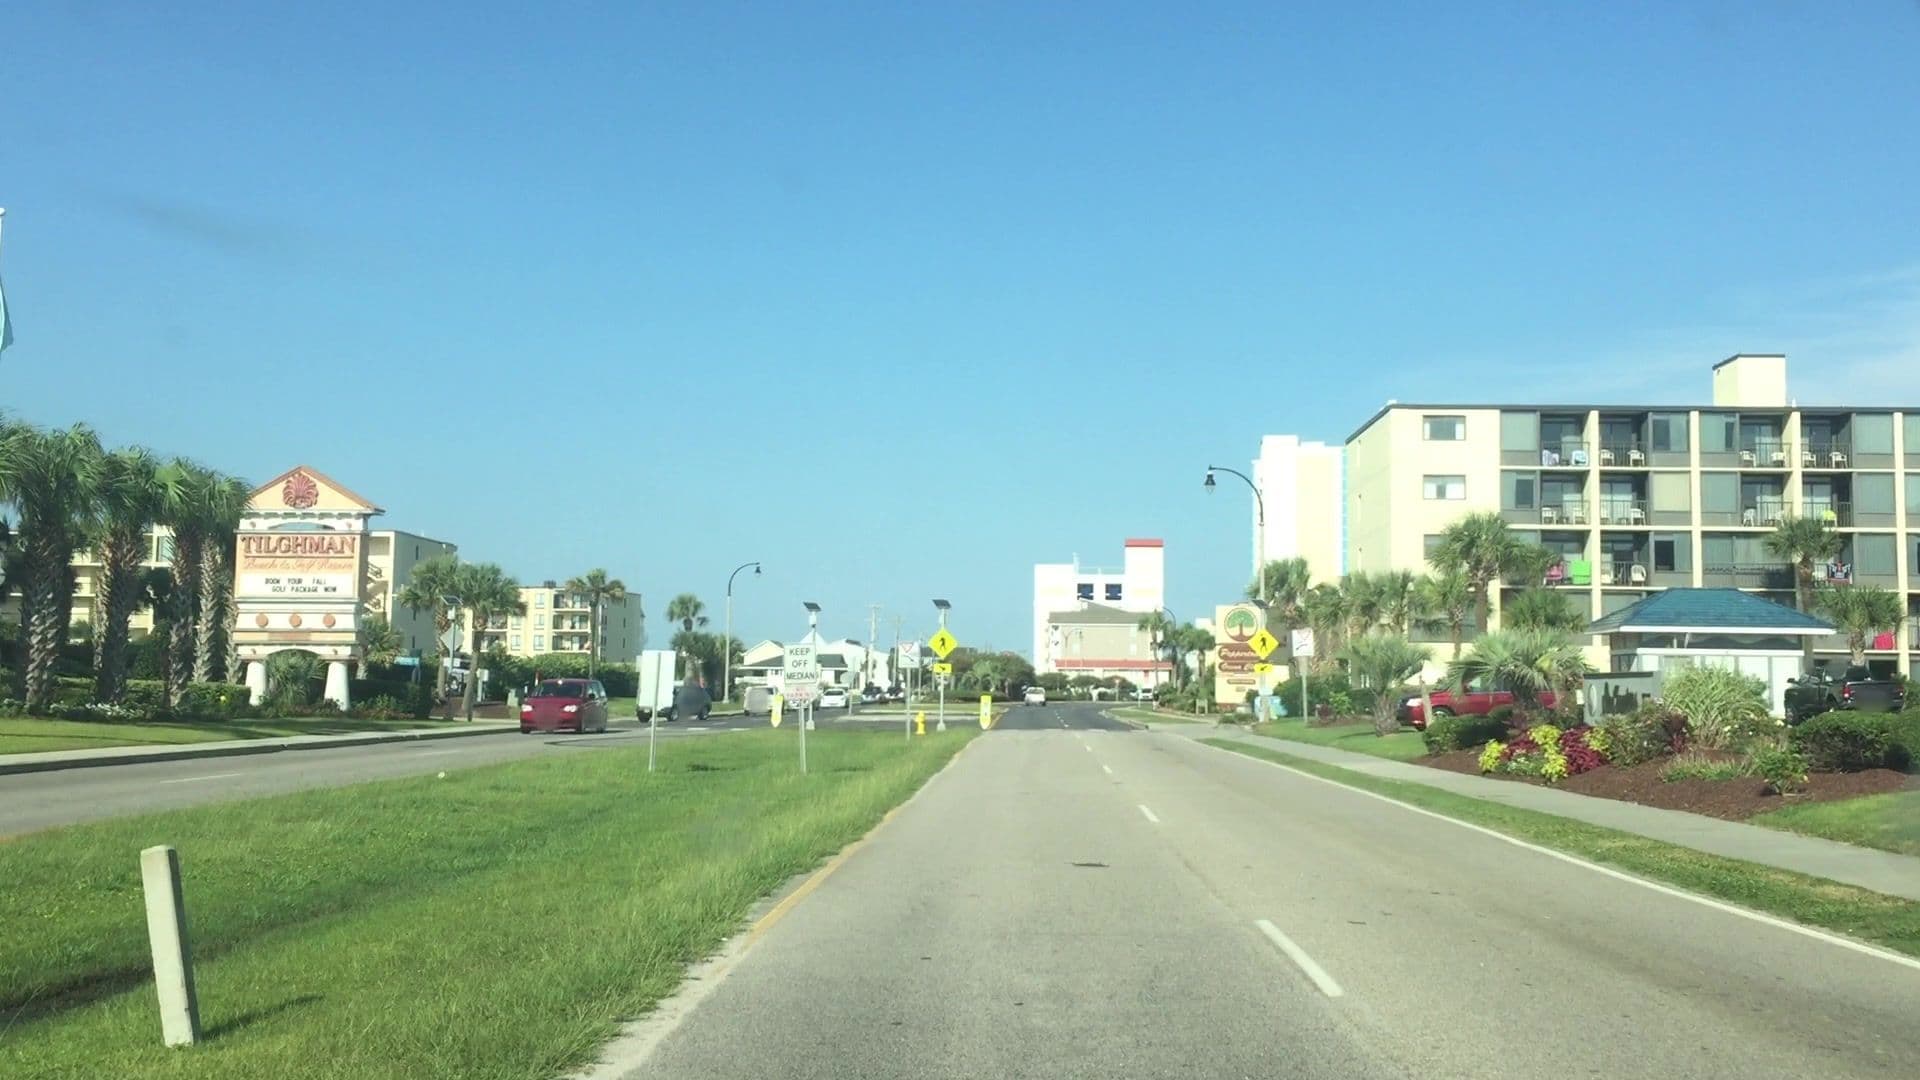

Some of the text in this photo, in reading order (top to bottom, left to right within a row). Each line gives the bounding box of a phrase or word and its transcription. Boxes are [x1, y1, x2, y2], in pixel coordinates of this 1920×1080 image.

[241, 535, 356, 554] TILGHMAN
[265, 577, 327, 585] BOOK YOUR FALL
[789, 648, 810, 656] KEEP
[791, 659, 808, 668] OFF
[786, 672, 815, 680] MEDIAN
